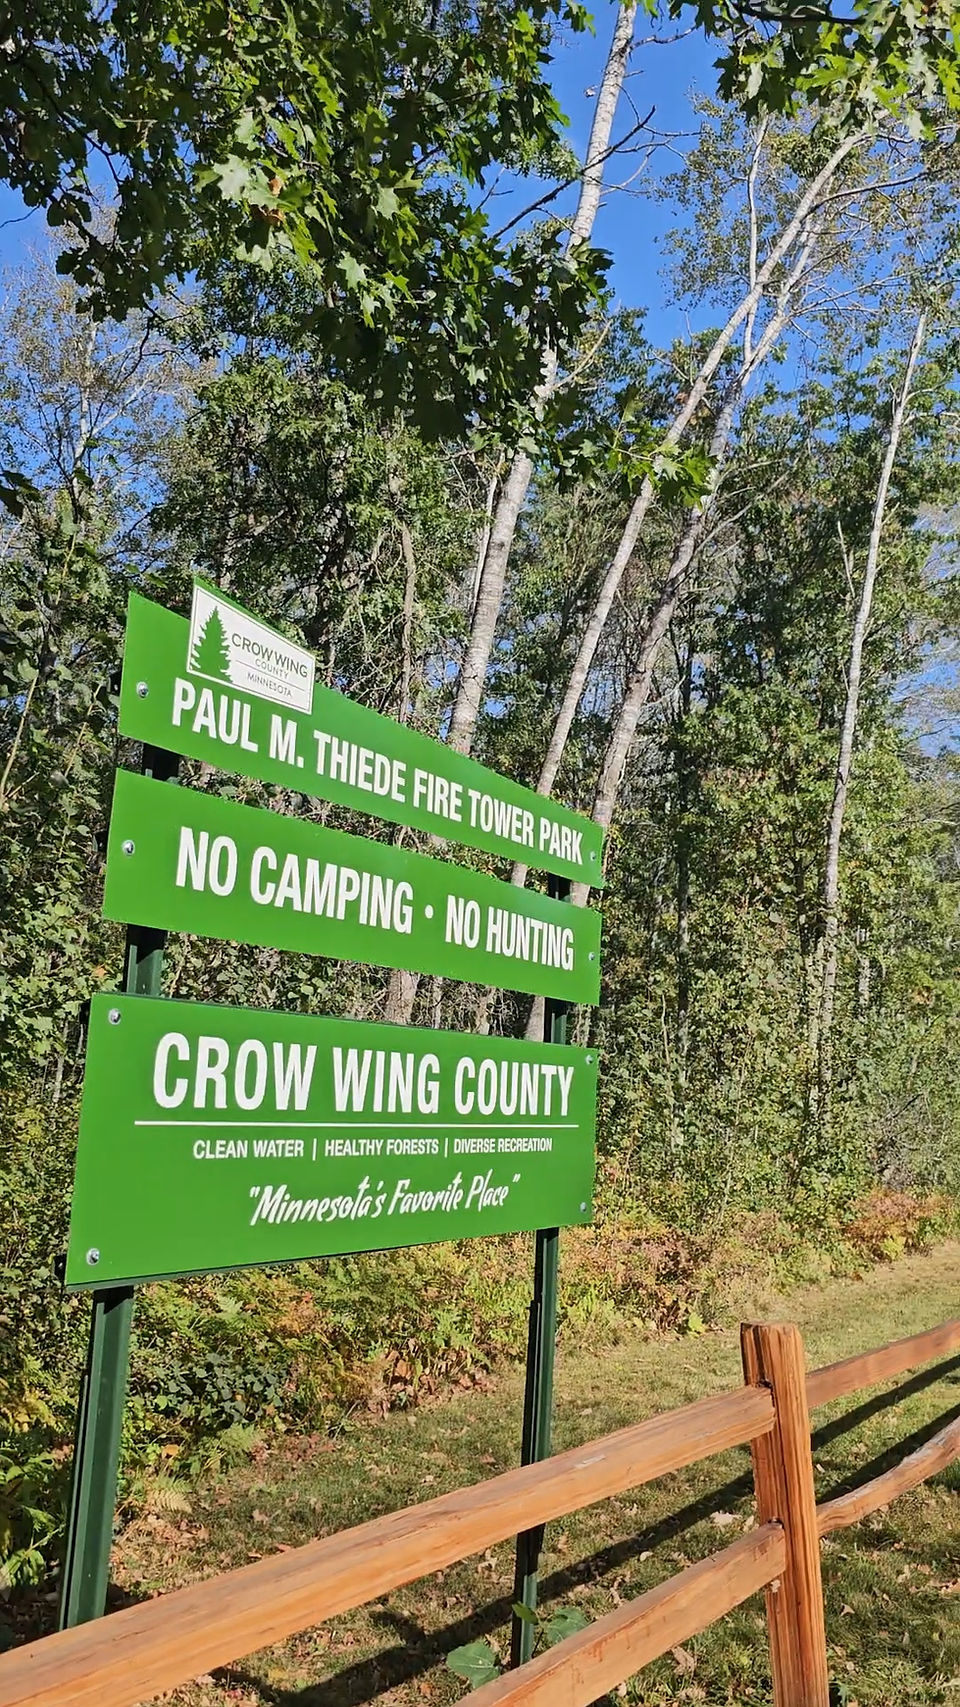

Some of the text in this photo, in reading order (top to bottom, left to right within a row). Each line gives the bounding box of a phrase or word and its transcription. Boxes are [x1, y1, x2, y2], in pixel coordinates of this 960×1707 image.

[232, 633, 308, 678] CROW WING
[255, 658, 289, 679] COUNTY
[247, 673, 292, 697] MINNESOTA
[172, 677, 583, 865] PAUL M. THIEDE FIRE TOWER PARK
[175, 826, 238, 897] NO
[250, 846, 414, 934] CAMPING
[445, 894, 481, 949] NO
[486, 908, 574, 971] HUNTING
[153, 1032, 574, 1116] CROW WING COUNTY
[193, 1139, 248, 1159] CLEAN
[253, 1139, 304, 1158] WATER
[324, 1138, 383, 1156] HEALTHY
[386, 1138, 439, 1155] FORESTS
[453, 1138, 496, 1154] DIVERSE
[497, 1138, 552, 1153] RECREATION
[387, 1171, 464, 1215] Favorite
